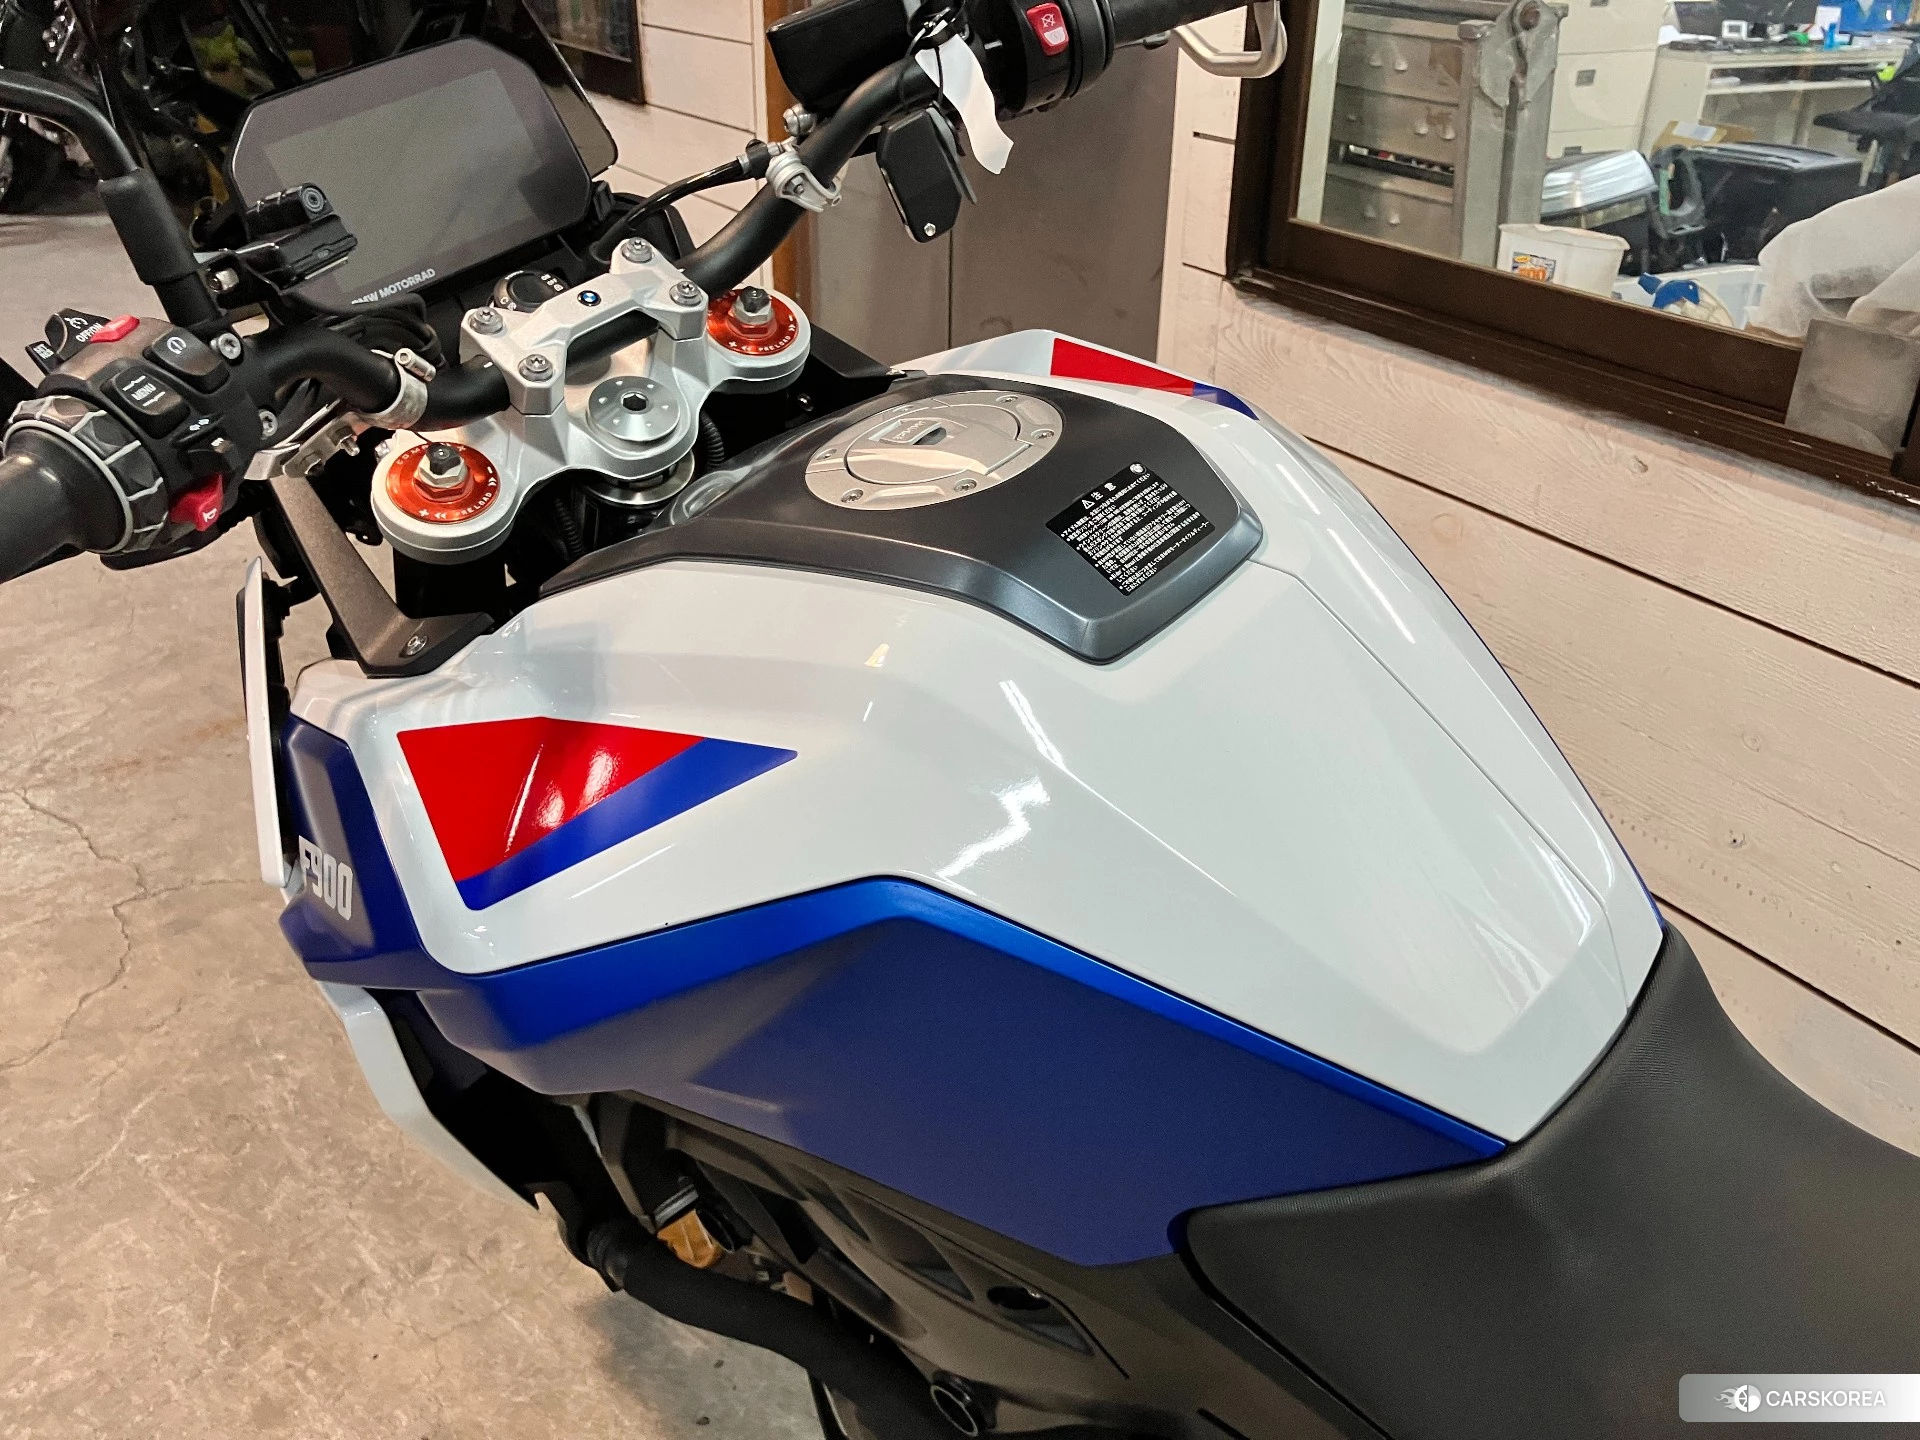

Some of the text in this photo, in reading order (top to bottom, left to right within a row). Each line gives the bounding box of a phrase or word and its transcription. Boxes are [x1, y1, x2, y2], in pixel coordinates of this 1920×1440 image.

[378, 268, 436, 298] MOTORRAD
[758, 335, 792, 352] PRELOAD
[131, 383, 157, 401] MENU
[455, 492, 493, 517] PRELOAD
[299, 835, 353, 920] F900
